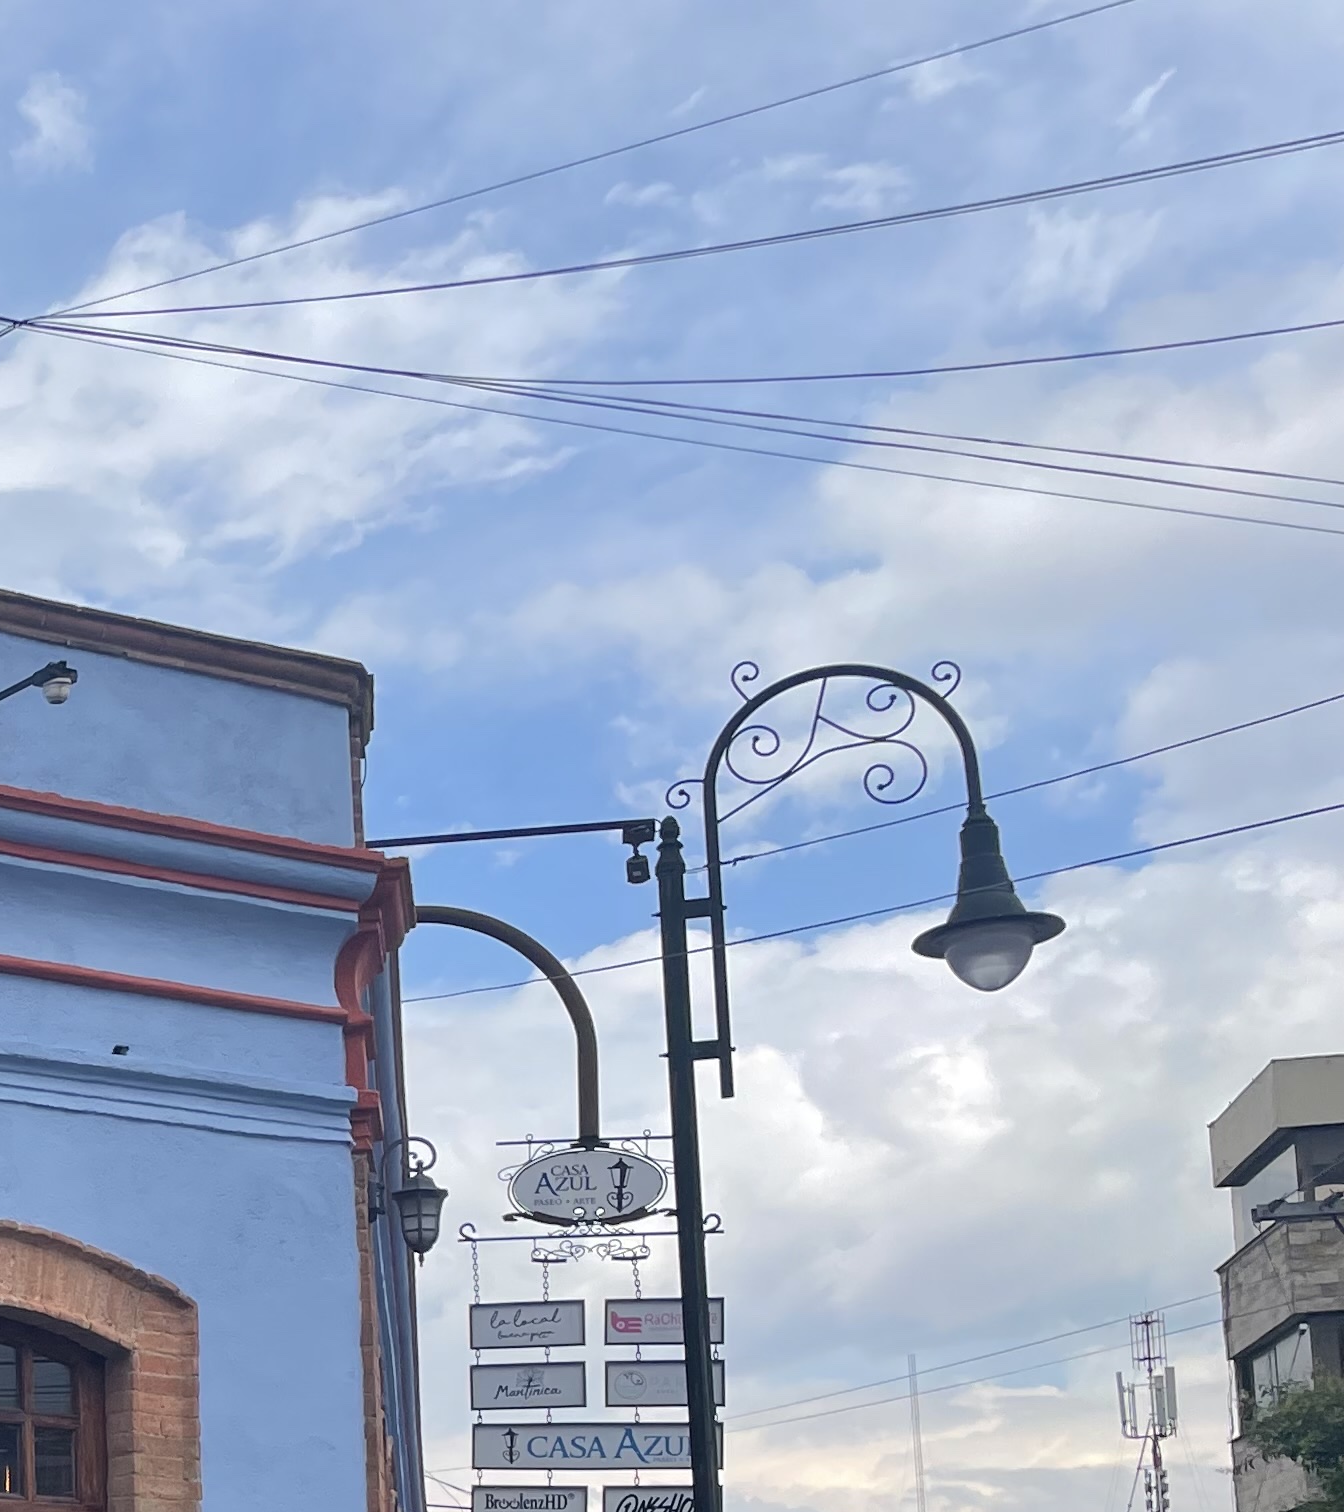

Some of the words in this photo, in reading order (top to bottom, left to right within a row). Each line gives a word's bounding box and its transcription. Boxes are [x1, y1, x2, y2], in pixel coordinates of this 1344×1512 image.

[550, 1163, 589, 1176] CASA
[534, 1172, 598, 1196] AZUL
[534, 1197, 563, 1206] PASEO
[573, 1196, 597, 1205] ARTE
[527, 1435, 607, 1459] CASA
